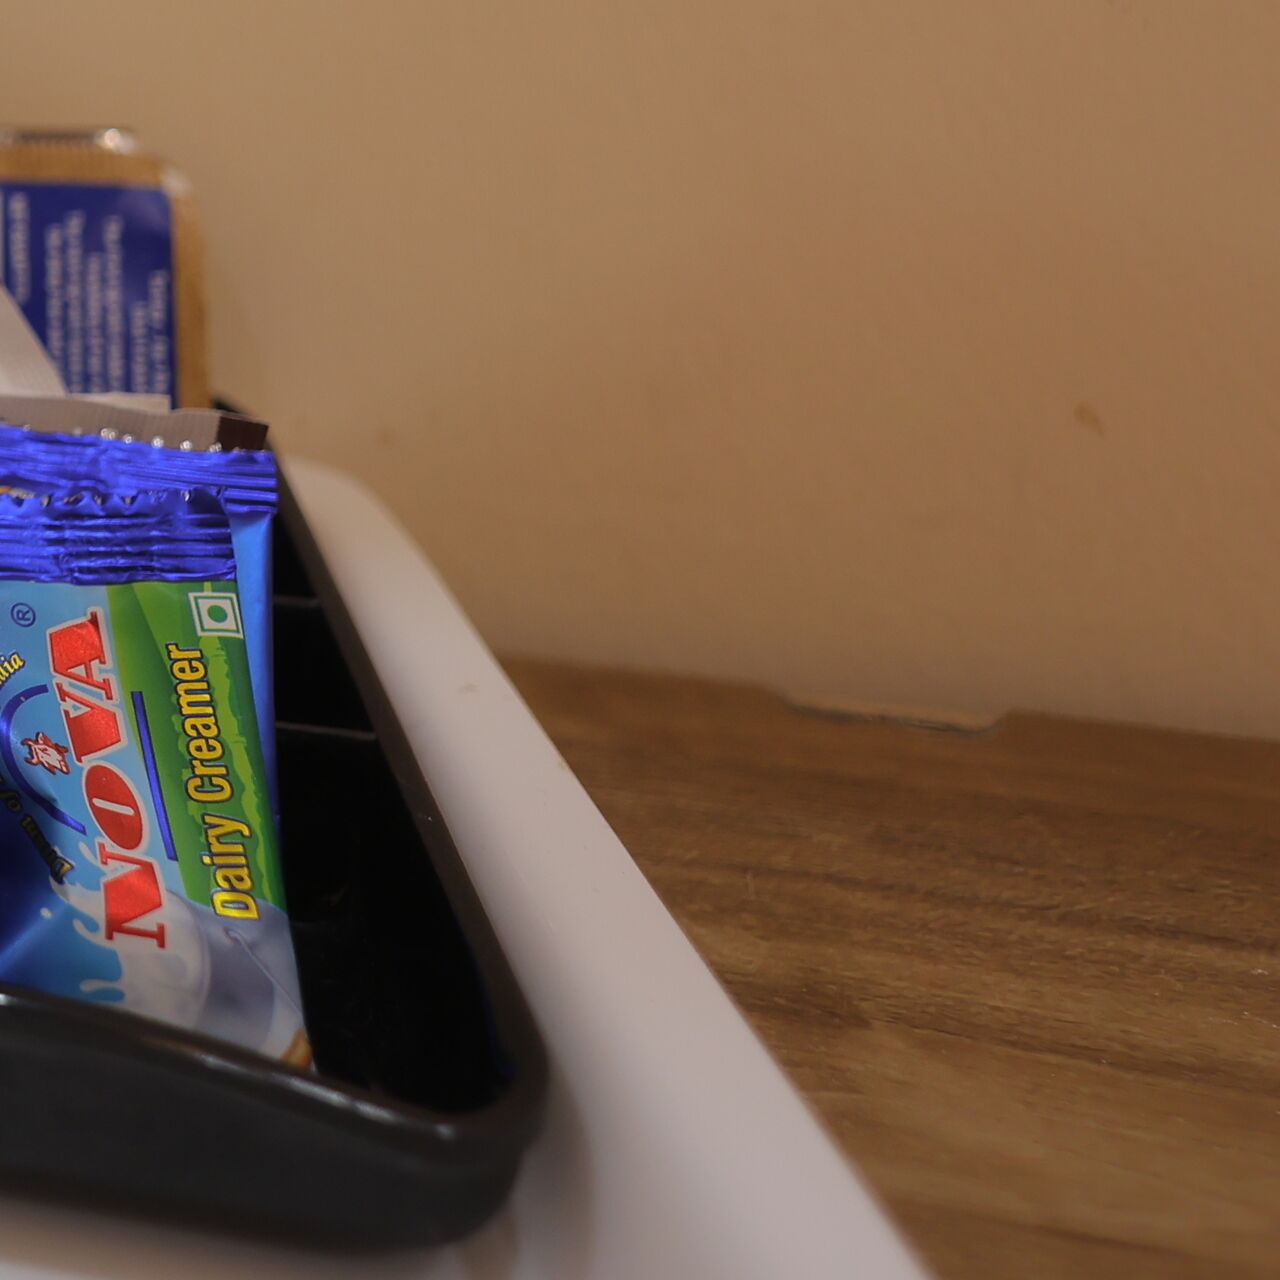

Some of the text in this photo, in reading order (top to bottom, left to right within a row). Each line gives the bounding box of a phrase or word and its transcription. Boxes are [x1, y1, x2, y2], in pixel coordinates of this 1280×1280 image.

[46, 609, 167, 950] NOVA
[165, 640, 260, 921] Dairy Creamer
